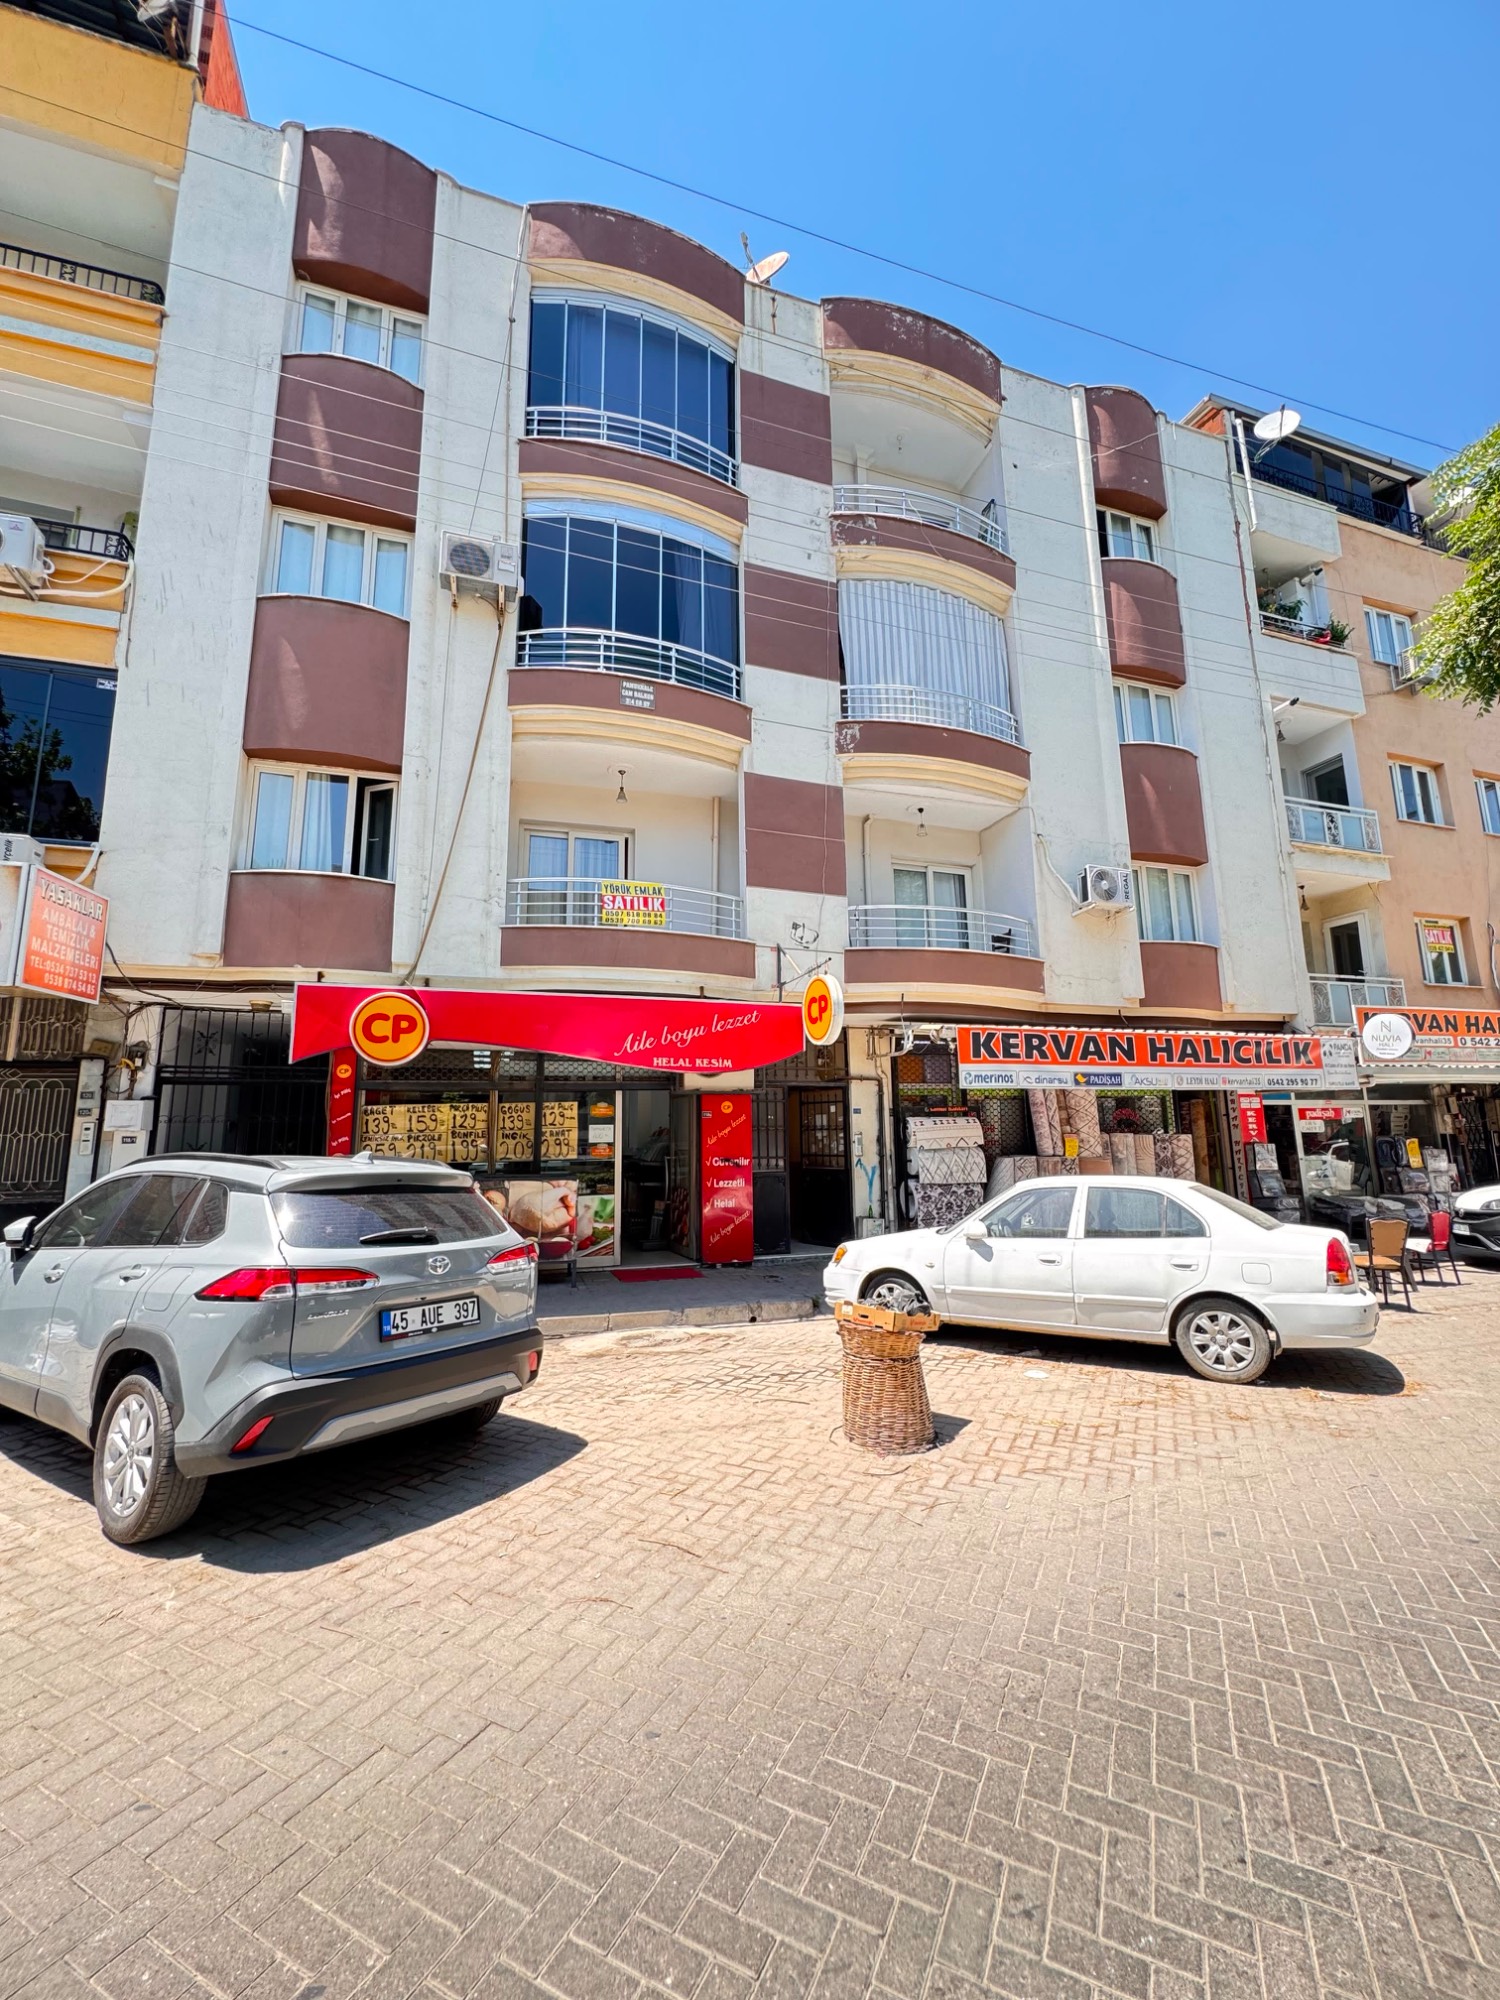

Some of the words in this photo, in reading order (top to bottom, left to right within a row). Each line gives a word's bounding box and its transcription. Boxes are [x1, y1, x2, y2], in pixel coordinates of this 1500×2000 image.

[622, 689, 633, 697] CAM
[3, 838, 13, 861] rçelik
[604, 884, 632, 894] YÖRÜK
[634, 886, 663, 896] EMLAK
[1122, 873, 1130, 900] REGAL
[40, 877, 103, 922] YASAKLAR
[603, 895, 664, 911] SATILIK
[42, 908, 88, 935] AMBALAJ
[89, 925, 96, 938] &
[47, 925, 91, 952] TEMİZLİK
[31, 936, 99, 969] MALZEMELERİ
[807, 994, 829, 1025] CP
[361, 1012, 418, 1045] CP
[1363, 1011, 1459, 1033] VAN
[613, 1030, 658, 1056] Aile
[661, 1025, 708, 1048] boyu
[711, 1010, 761, 1032] lezzet
[1371, 1034, 1402, 1043] NUVIA
[1460, 1038, 1467, 1046] 0
[1471, 1038, 1491, 1046] 542
[970, 1030, 1137, 1063] KERVAN
[1146, 1035, 1315, 1066] HALICILIK
[653, 1057, 692, 1067] HELAL
[695, 1056, 733, 1068] KESİM
[973, 1071, 1014, 1084] merinos
[1034, 1072, 1068, 1085] dinarsu
[1089, 1073, 1122, 1086] PADİŞAH
[1134, 1076, 1158, 1086] AKSU
[1267, 1078, 1285, 1086] 0542
[363, 1105, 397, 1117] BAGET
[407, 1104, 445, 1114] KELEBEK
[1305, 1108, 1335, 1120] padişah
[362, 1115, 391, 1135] 139
[406, 1113, 438, 1133] 159
[450, 1112, 477, 1129] 129
[500, 1115, 525, 1131] 139
[717, 1126, 731, 1138] boyu
[731, 1113, 746, 1129] lezzet
[1246, 1110, 1260, 1142] KERVA
[450, 1139, 479, 1162] 199
[713, 1177, 745, 1188] Lezzetli
[714, 1198, 736, 1209] Helal
[720, 1222, 735, 1236] boyu
[734, 1210, 750, 1225] lezzet
[391, 1311, 409, 1332] 45
[420, 1305, 444, 1327] AUE
[454, 1300, 476, 1320] 397
